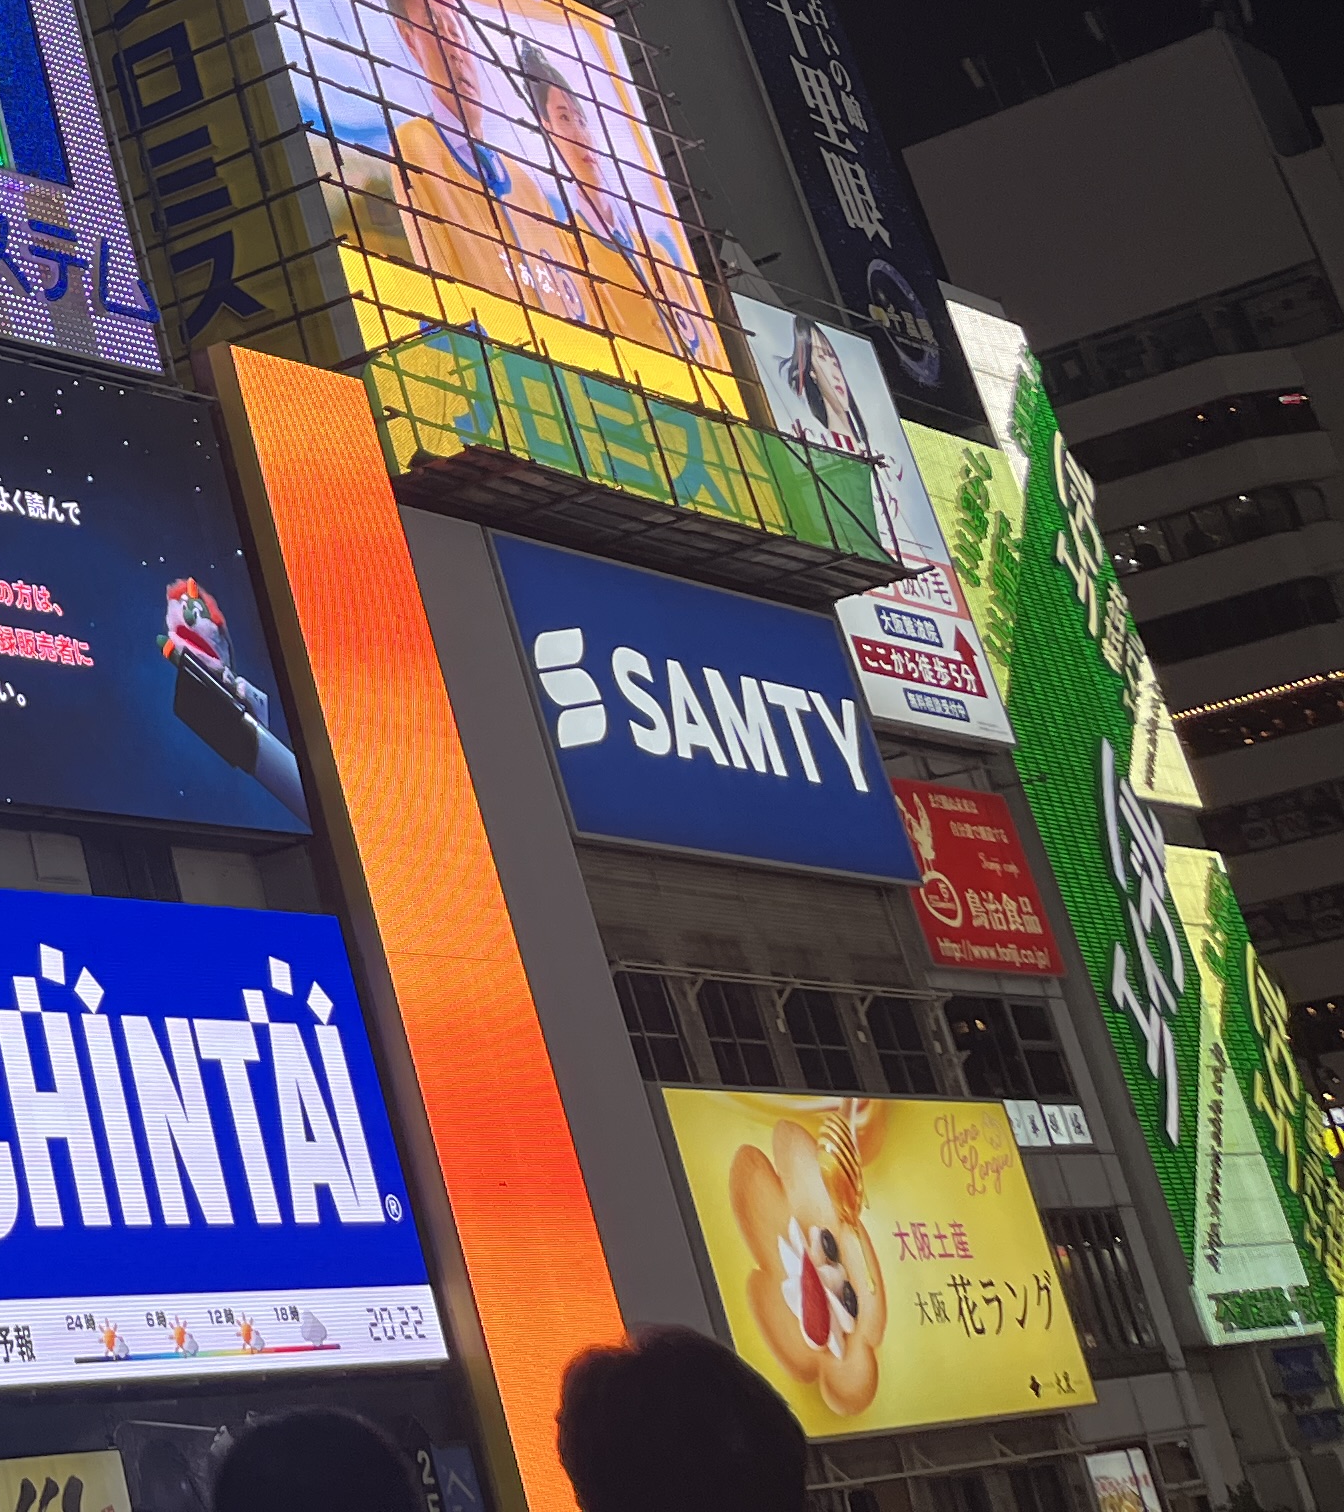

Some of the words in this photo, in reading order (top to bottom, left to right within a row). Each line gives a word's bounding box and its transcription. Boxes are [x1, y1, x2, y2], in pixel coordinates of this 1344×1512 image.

[862, 644, 977, 692] ここから徒歩5分
[611, 646, 869, 793] SAMTY
[1113, 776, 1184, 1078] エイブル
[892, 1221, 974, 1262] 大阪土産
[65, 1313, 96, 1331] 24時
[145, 1311, 167, 1329] 6時
[207, 1309, 235, 1326] 12時
[273, 1306, 300, 1324] 18時
[914, 1291, 951, 1325] 大阪
[947, 1270, 1053, 1338] 花ラング
